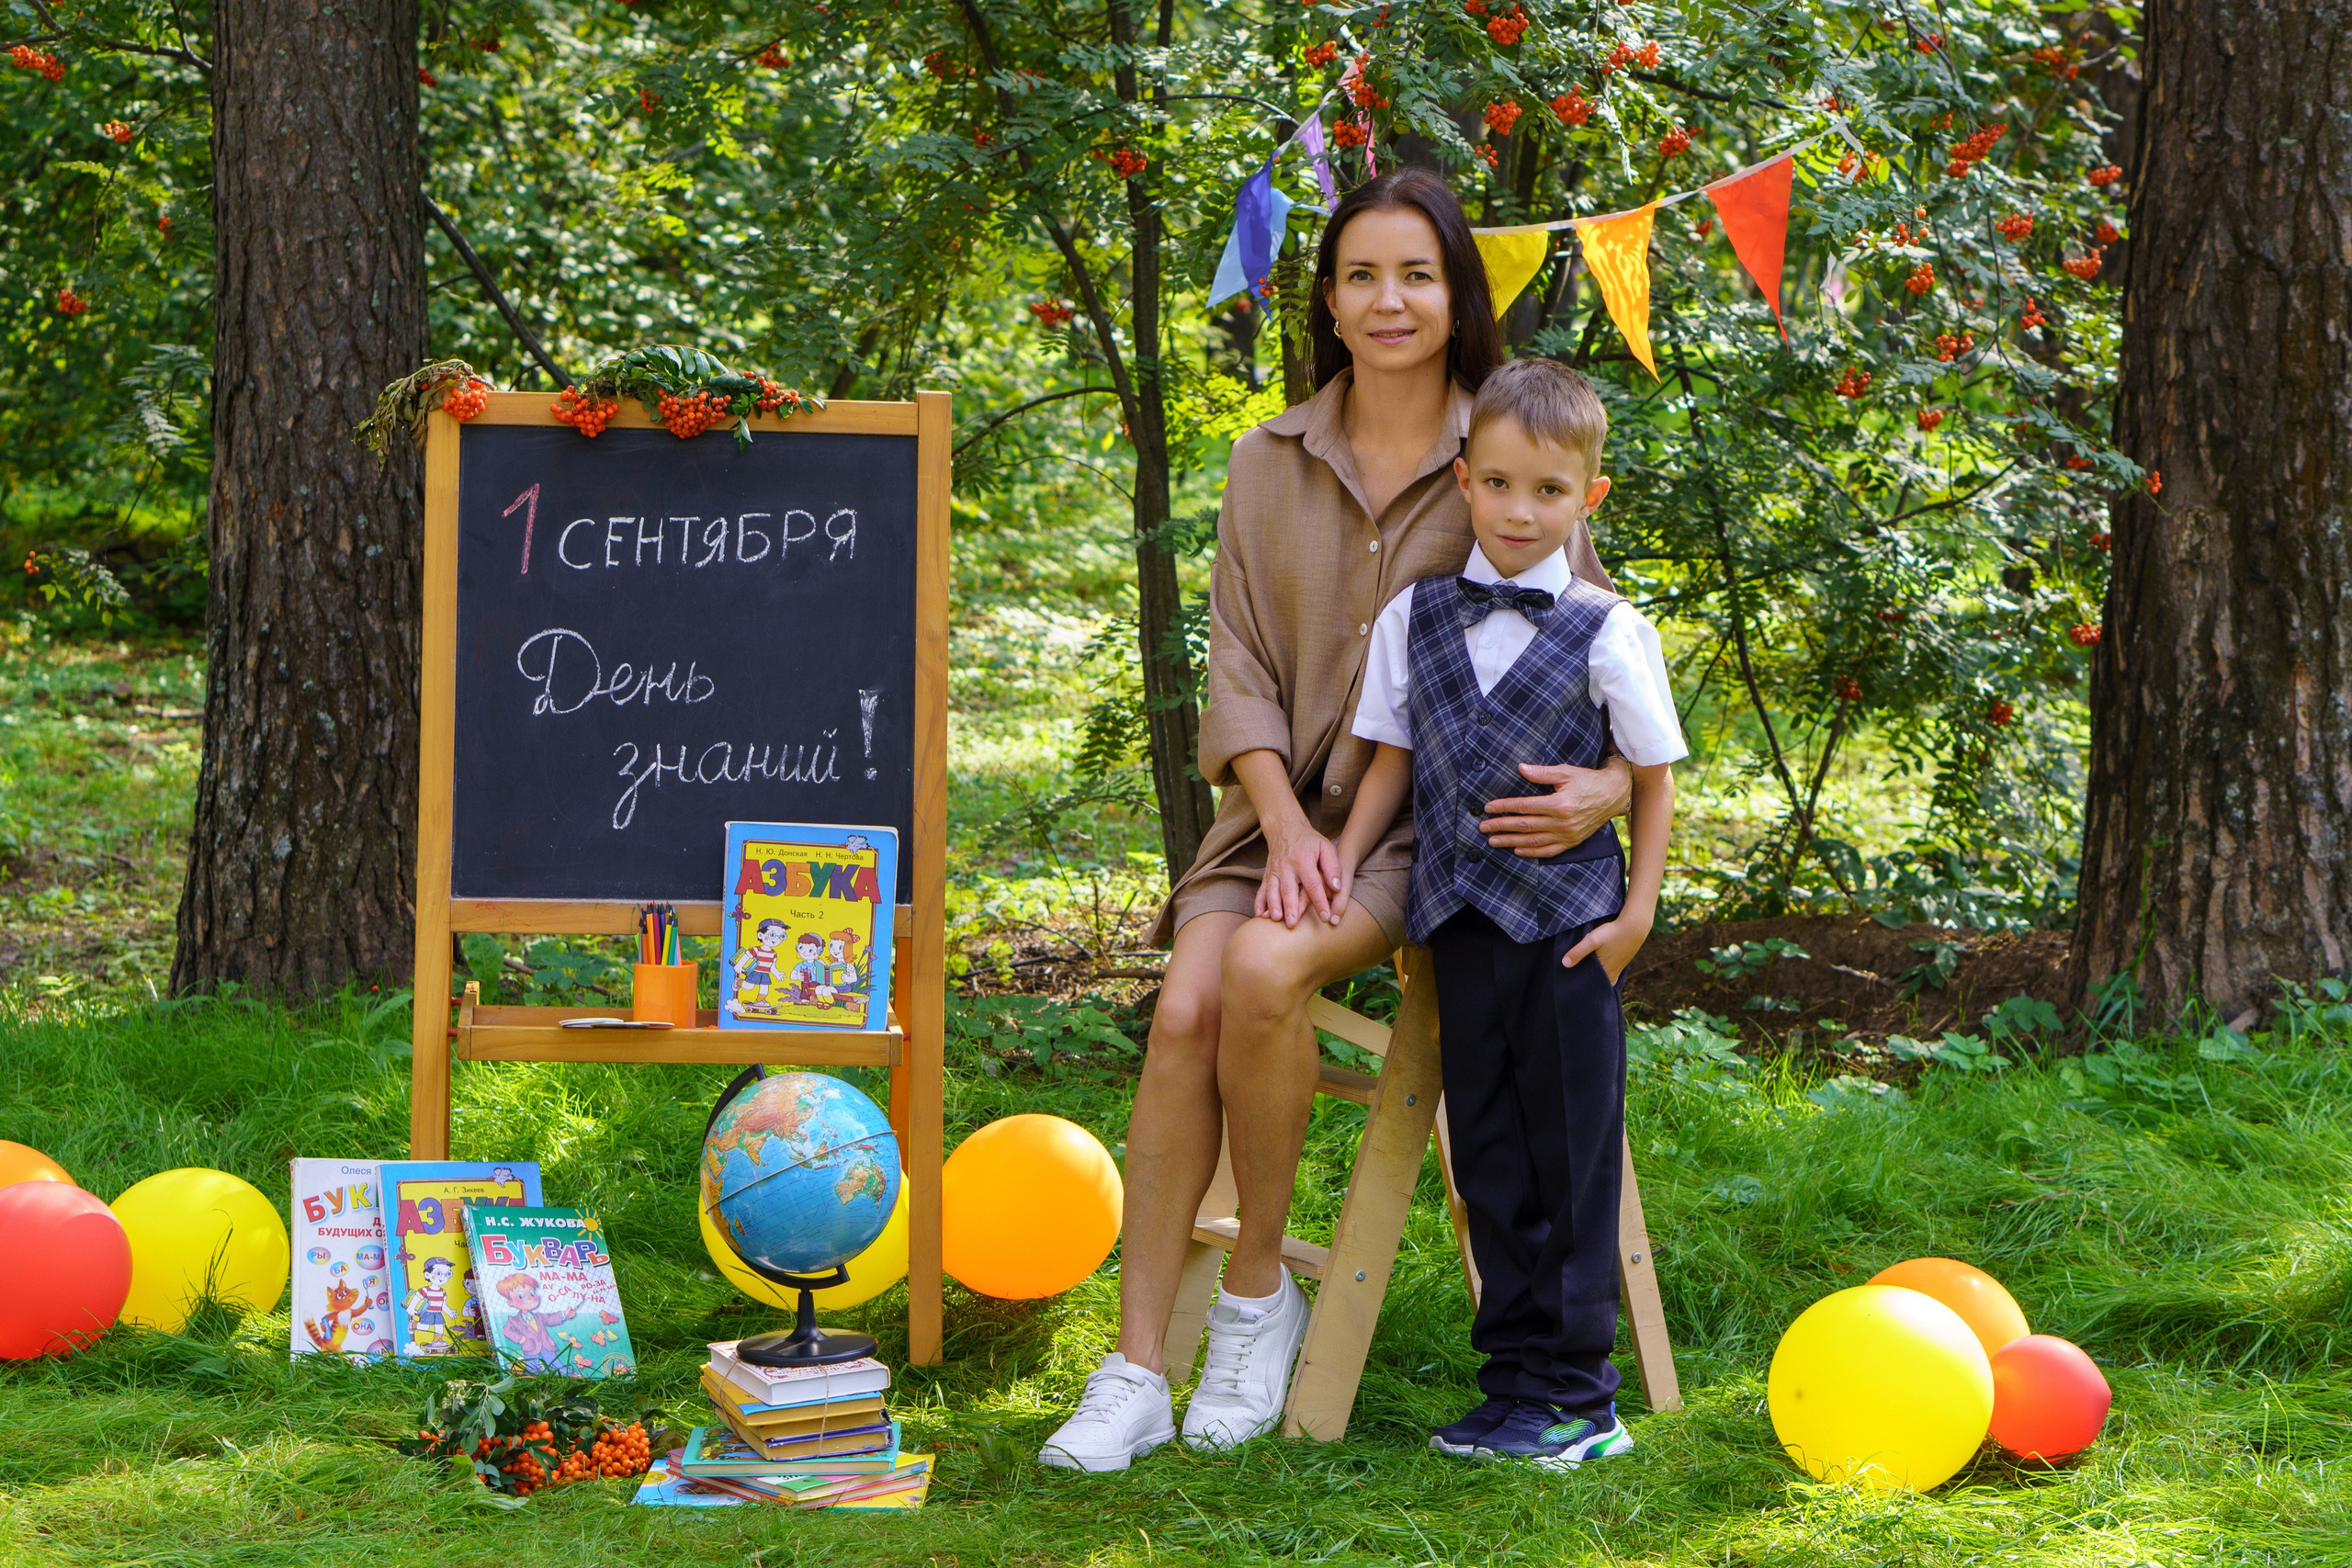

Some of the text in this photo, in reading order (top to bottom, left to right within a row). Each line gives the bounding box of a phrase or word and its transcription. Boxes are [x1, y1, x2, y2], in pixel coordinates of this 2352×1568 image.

[502, 483, 857, 574] 1 СЕНТЯБРЯ
[517, 628, 715, 716] День
[778, 848, 808, 857] Донская
[835, 852, 864, 862] Чертова
[734, 858, 883, 904] АЗБУКА
[790, 908, 824, 919] Часть 2
[341, 1166, 372, 1175] Олеся
[302, 1182, 379, 1223] БУК
[396, 1196, 525, 1236] АЗБ
[485, 1216, 587, 1229] Н.С. ЖУКОВА
[317, 1227, 373, 1238] БУДУЩИХ
[480, 1235, 611, 1270] БУКВАРЬ
[334, 1265, 347, 1274] БА
[539, 1271, 588, 1281] МА-МА
[581, 1279, 606, 1290] РО-ЗА
[548, 1285, 572, 1302] О-СА
[572, 1292, 606, 1304] ЛУ-НА
